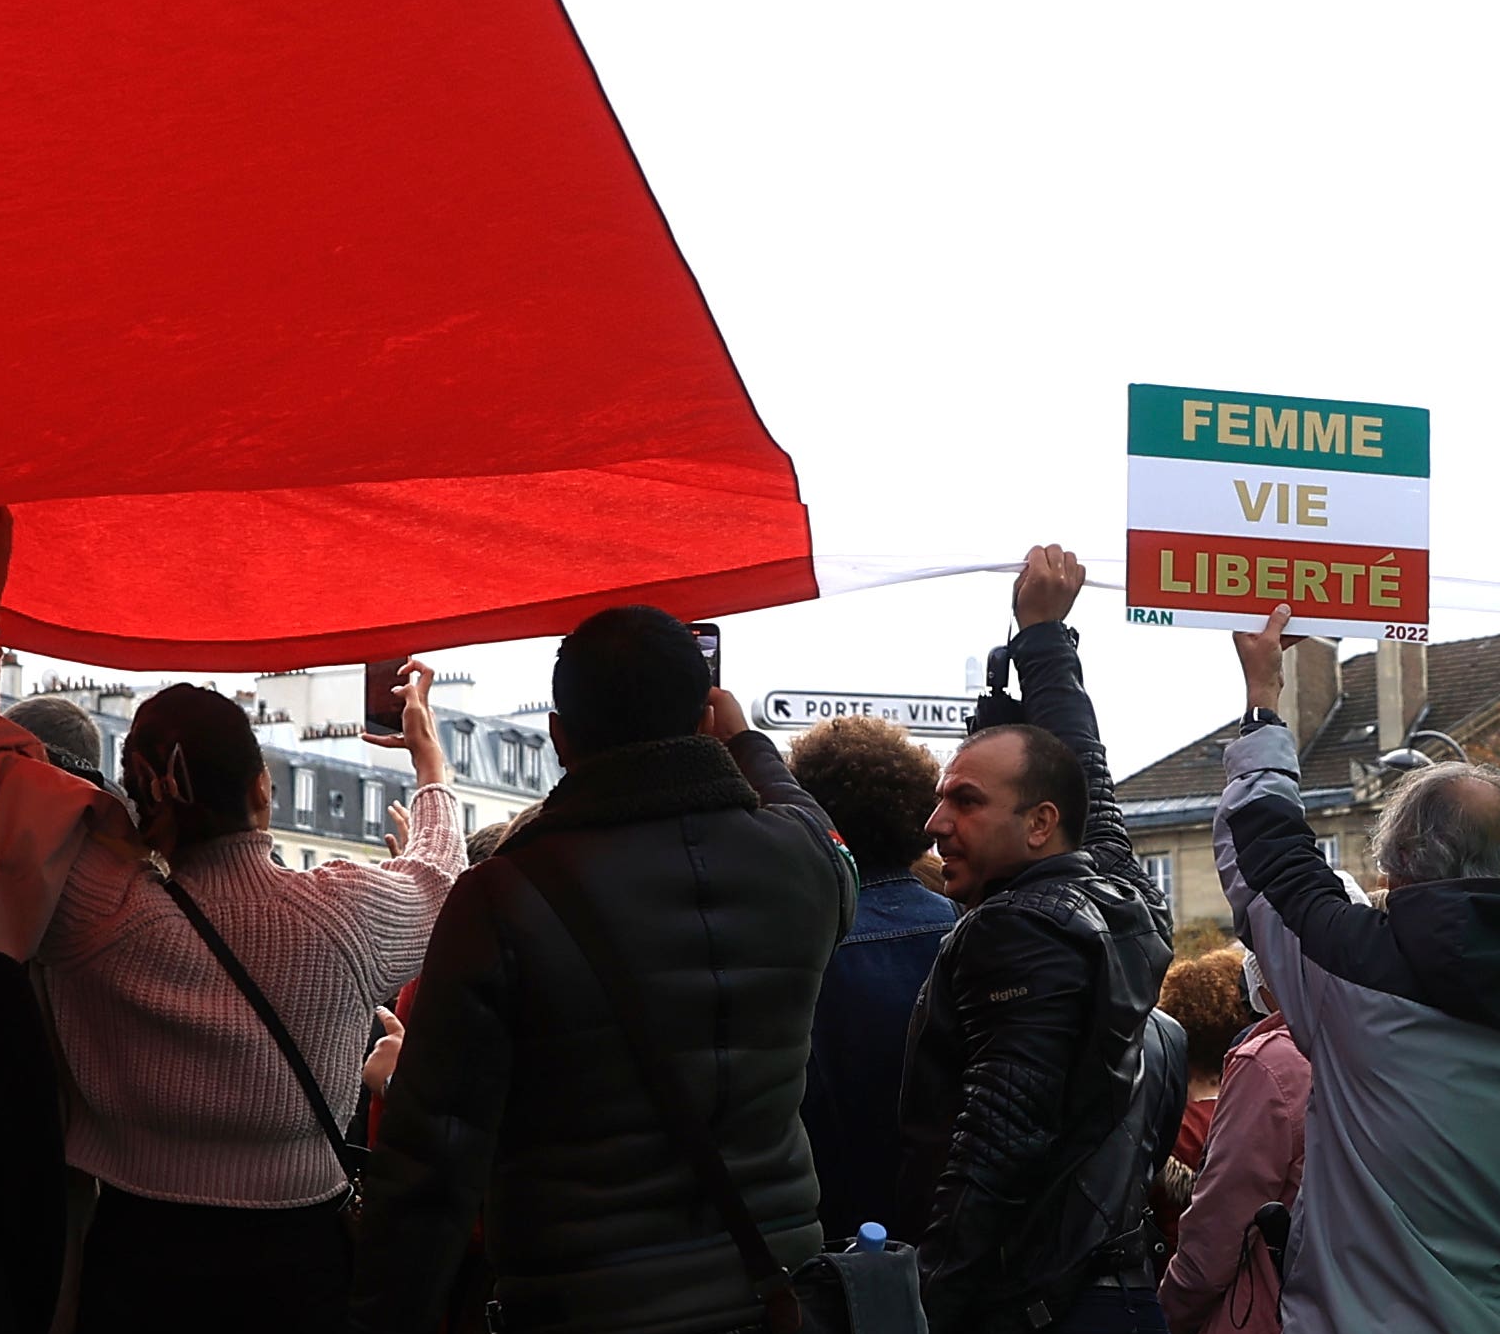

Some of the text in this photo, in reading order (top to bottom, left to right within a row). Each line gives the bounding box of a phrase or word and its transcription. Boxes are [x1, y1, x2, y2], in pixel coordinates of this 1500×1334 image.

[1182, 399, 1384, 458] FEMME
[1233, 479, 1329, 527] VIE
[1160, 549, 1402, 608] LIBERTÉ
[1126, 607, 1429, 642] IRAN 2022
[805, 699, 874, 717] PORTE
[908, 703, 978, 723] VINCE
